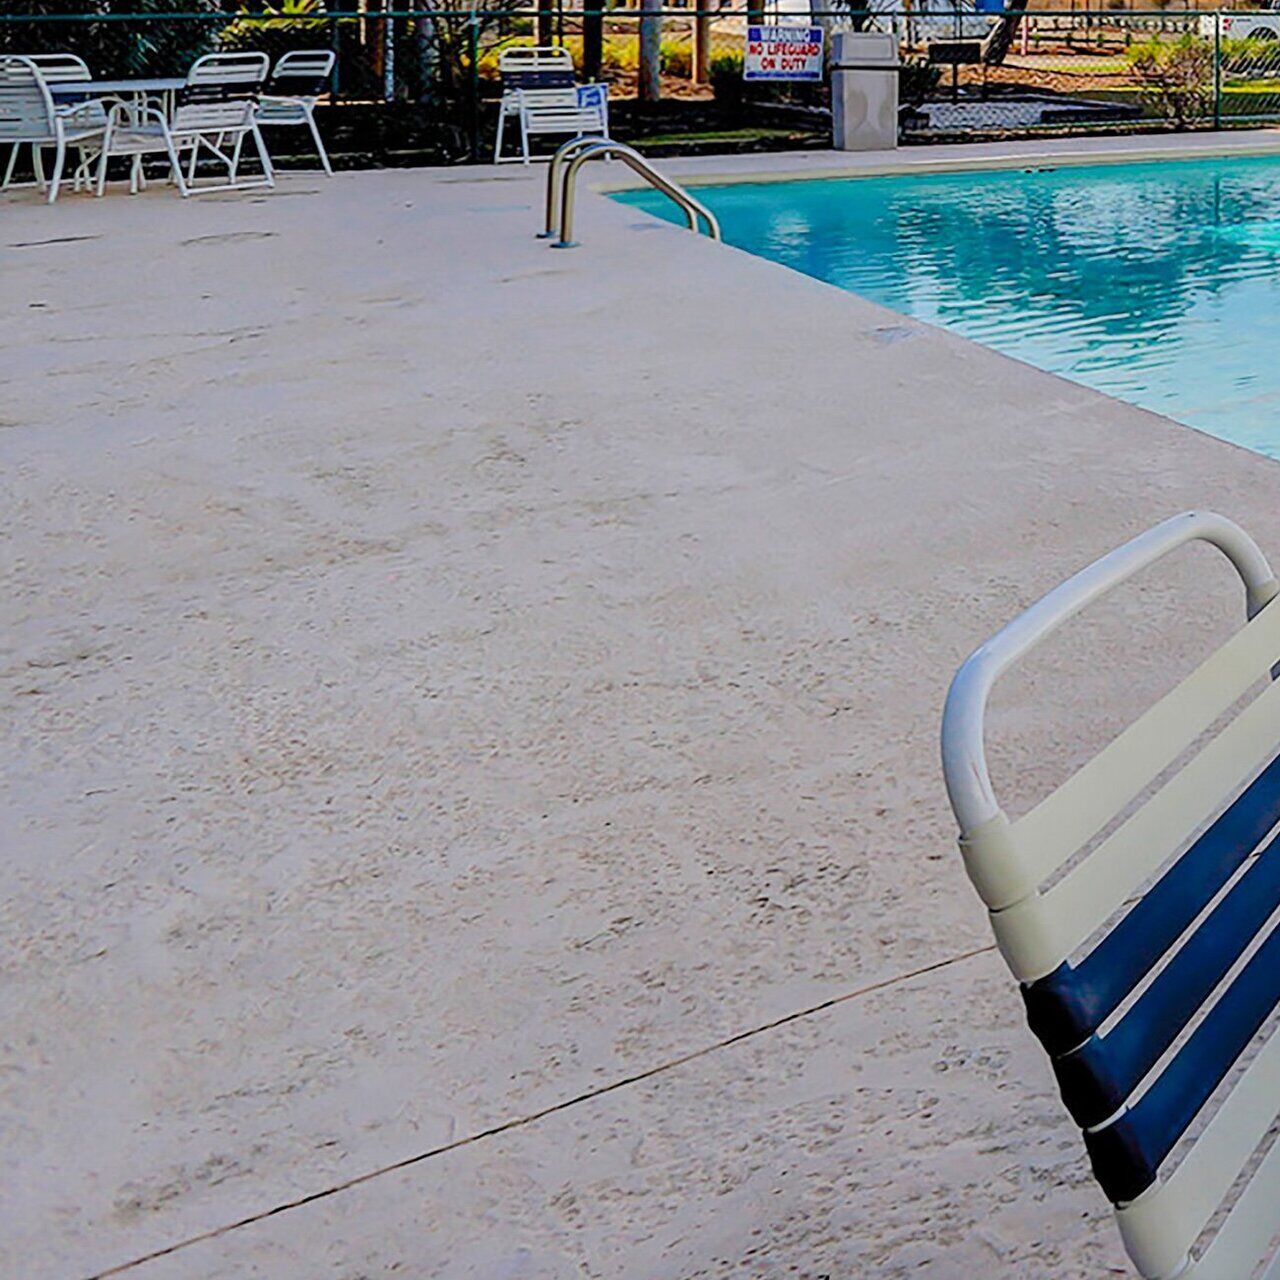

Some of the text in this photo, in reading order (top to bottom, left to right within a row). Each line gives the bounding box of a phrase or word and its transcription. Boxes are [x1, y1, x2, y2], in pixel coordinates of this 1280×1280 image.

[749, 42, 820, 57] NO LIFEGUARD
[761, 56, 807, 70] ON DUTY
